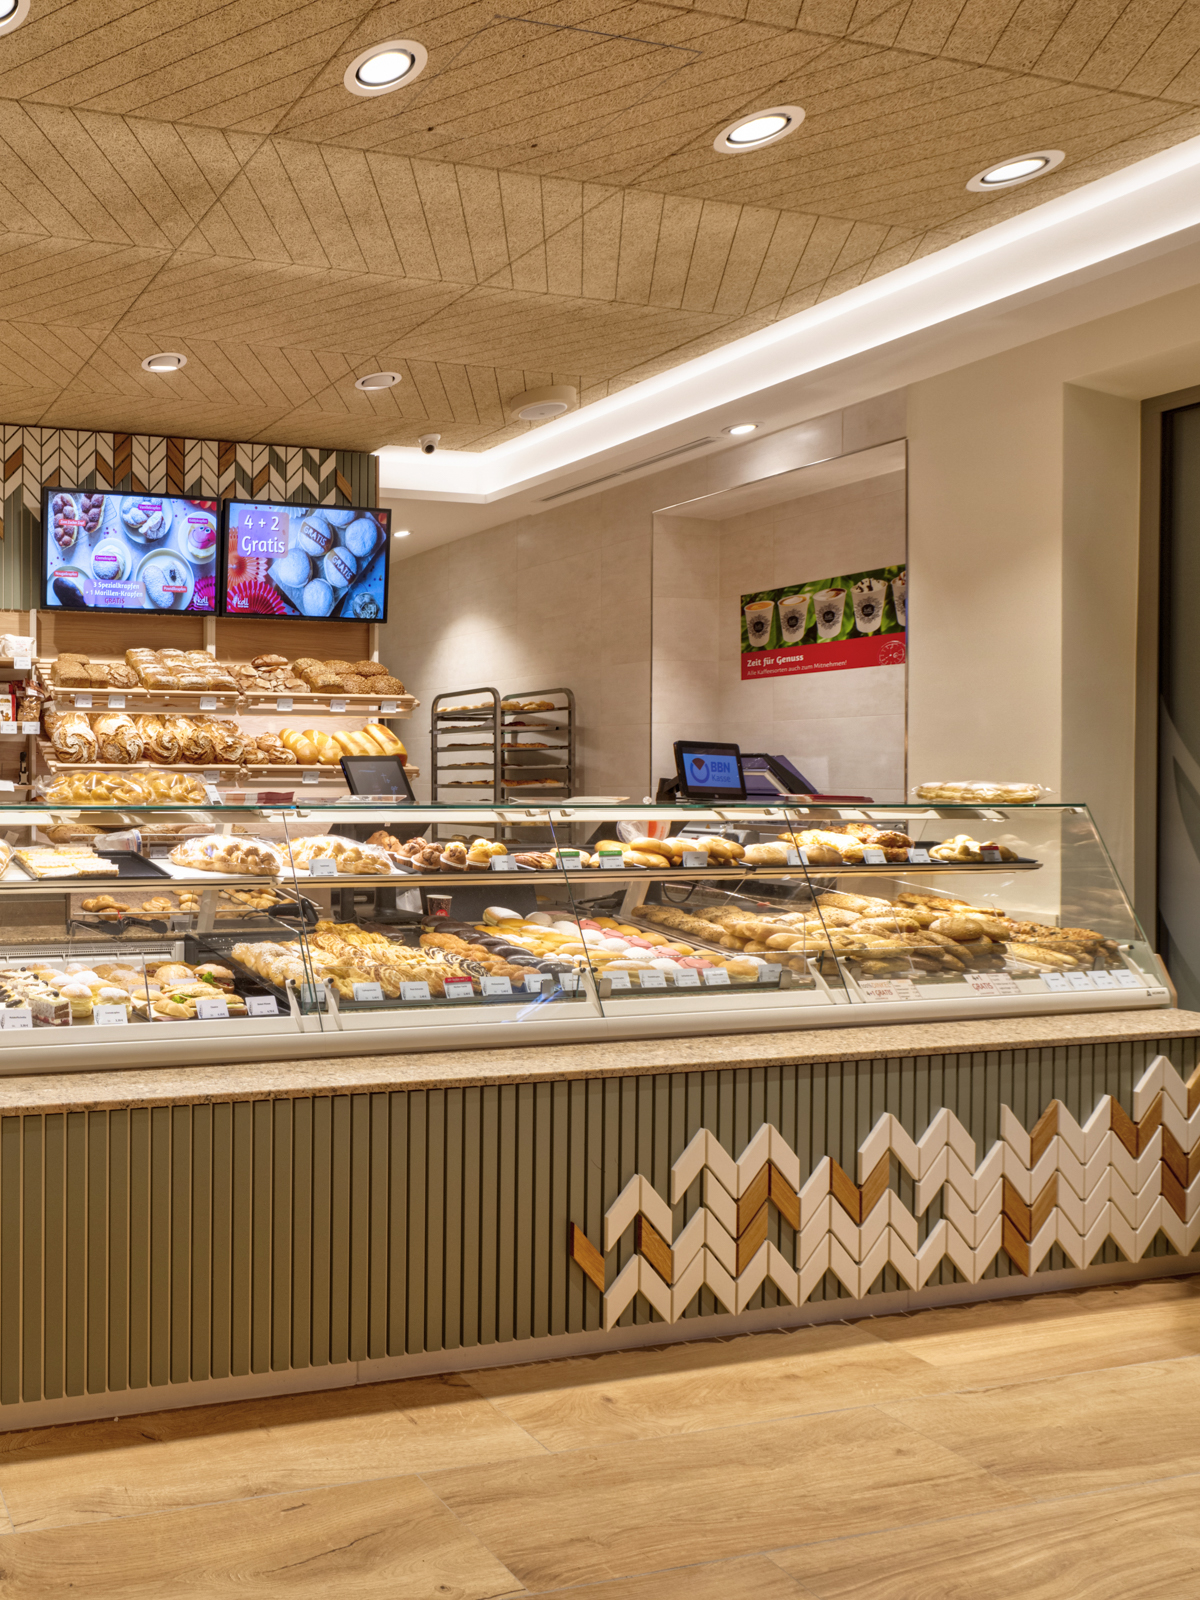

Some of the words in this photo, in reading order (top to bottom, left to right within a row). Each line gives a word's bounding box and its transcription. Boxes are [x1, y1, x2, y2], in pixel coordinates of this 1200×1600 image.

[244, 514, 254, 529] 4
[258, 520, 267, 528] +
[270, 516, 280, 531] 2
[303, 525, 327, 547] GRATIS
[241, 535, 286, 556] Gratis
[331, 555, 353, 580] GRATIS
[98, 582, 140, 591] Spezialkrapfen
[94, 590, 143, 598] Marillen-Krapfen
[104, 597, 125, 605] GRATIS
[747, 659, 762, 667] Zeit
[763, 657, 775, 667] für
[776, 655, 804, 665] Genuss
[757, 666, 787, 675] Kaffeesorten
[813, 660, 848, 669] Mitnehmen!
[711, 761, 731, 773] BBN
[711, 773, 731, 783] Kasse
